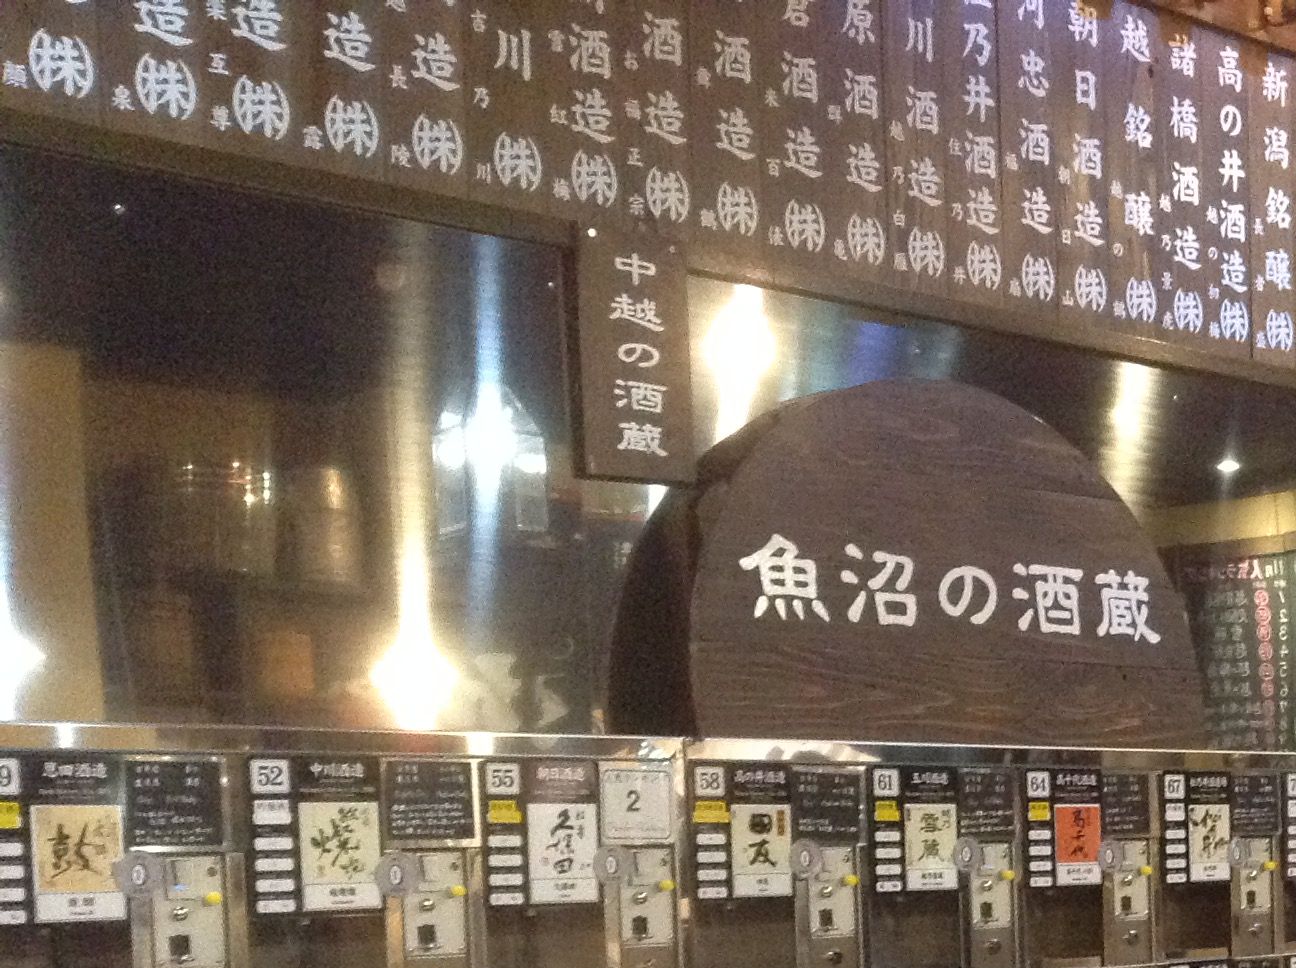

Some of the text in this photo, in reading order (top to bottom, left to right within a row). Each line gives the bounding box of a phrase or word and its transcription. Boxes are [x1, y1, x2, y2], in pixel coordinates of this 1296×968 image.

[611, 253, 669, 457] 中越の酒蔵
[740, 533, 1161, 644] 魚沼の酒蔵
[256, 765, 283, 786] 52
[491, 768, 515, 788] 55
[699, 772, 721, 791] 58
[877, 773, 895, 792] 61
[1030, 780, 1047, 794] 64
[1167, 780, 1182, 795] 67
[626, 790, 641, 813] 2
